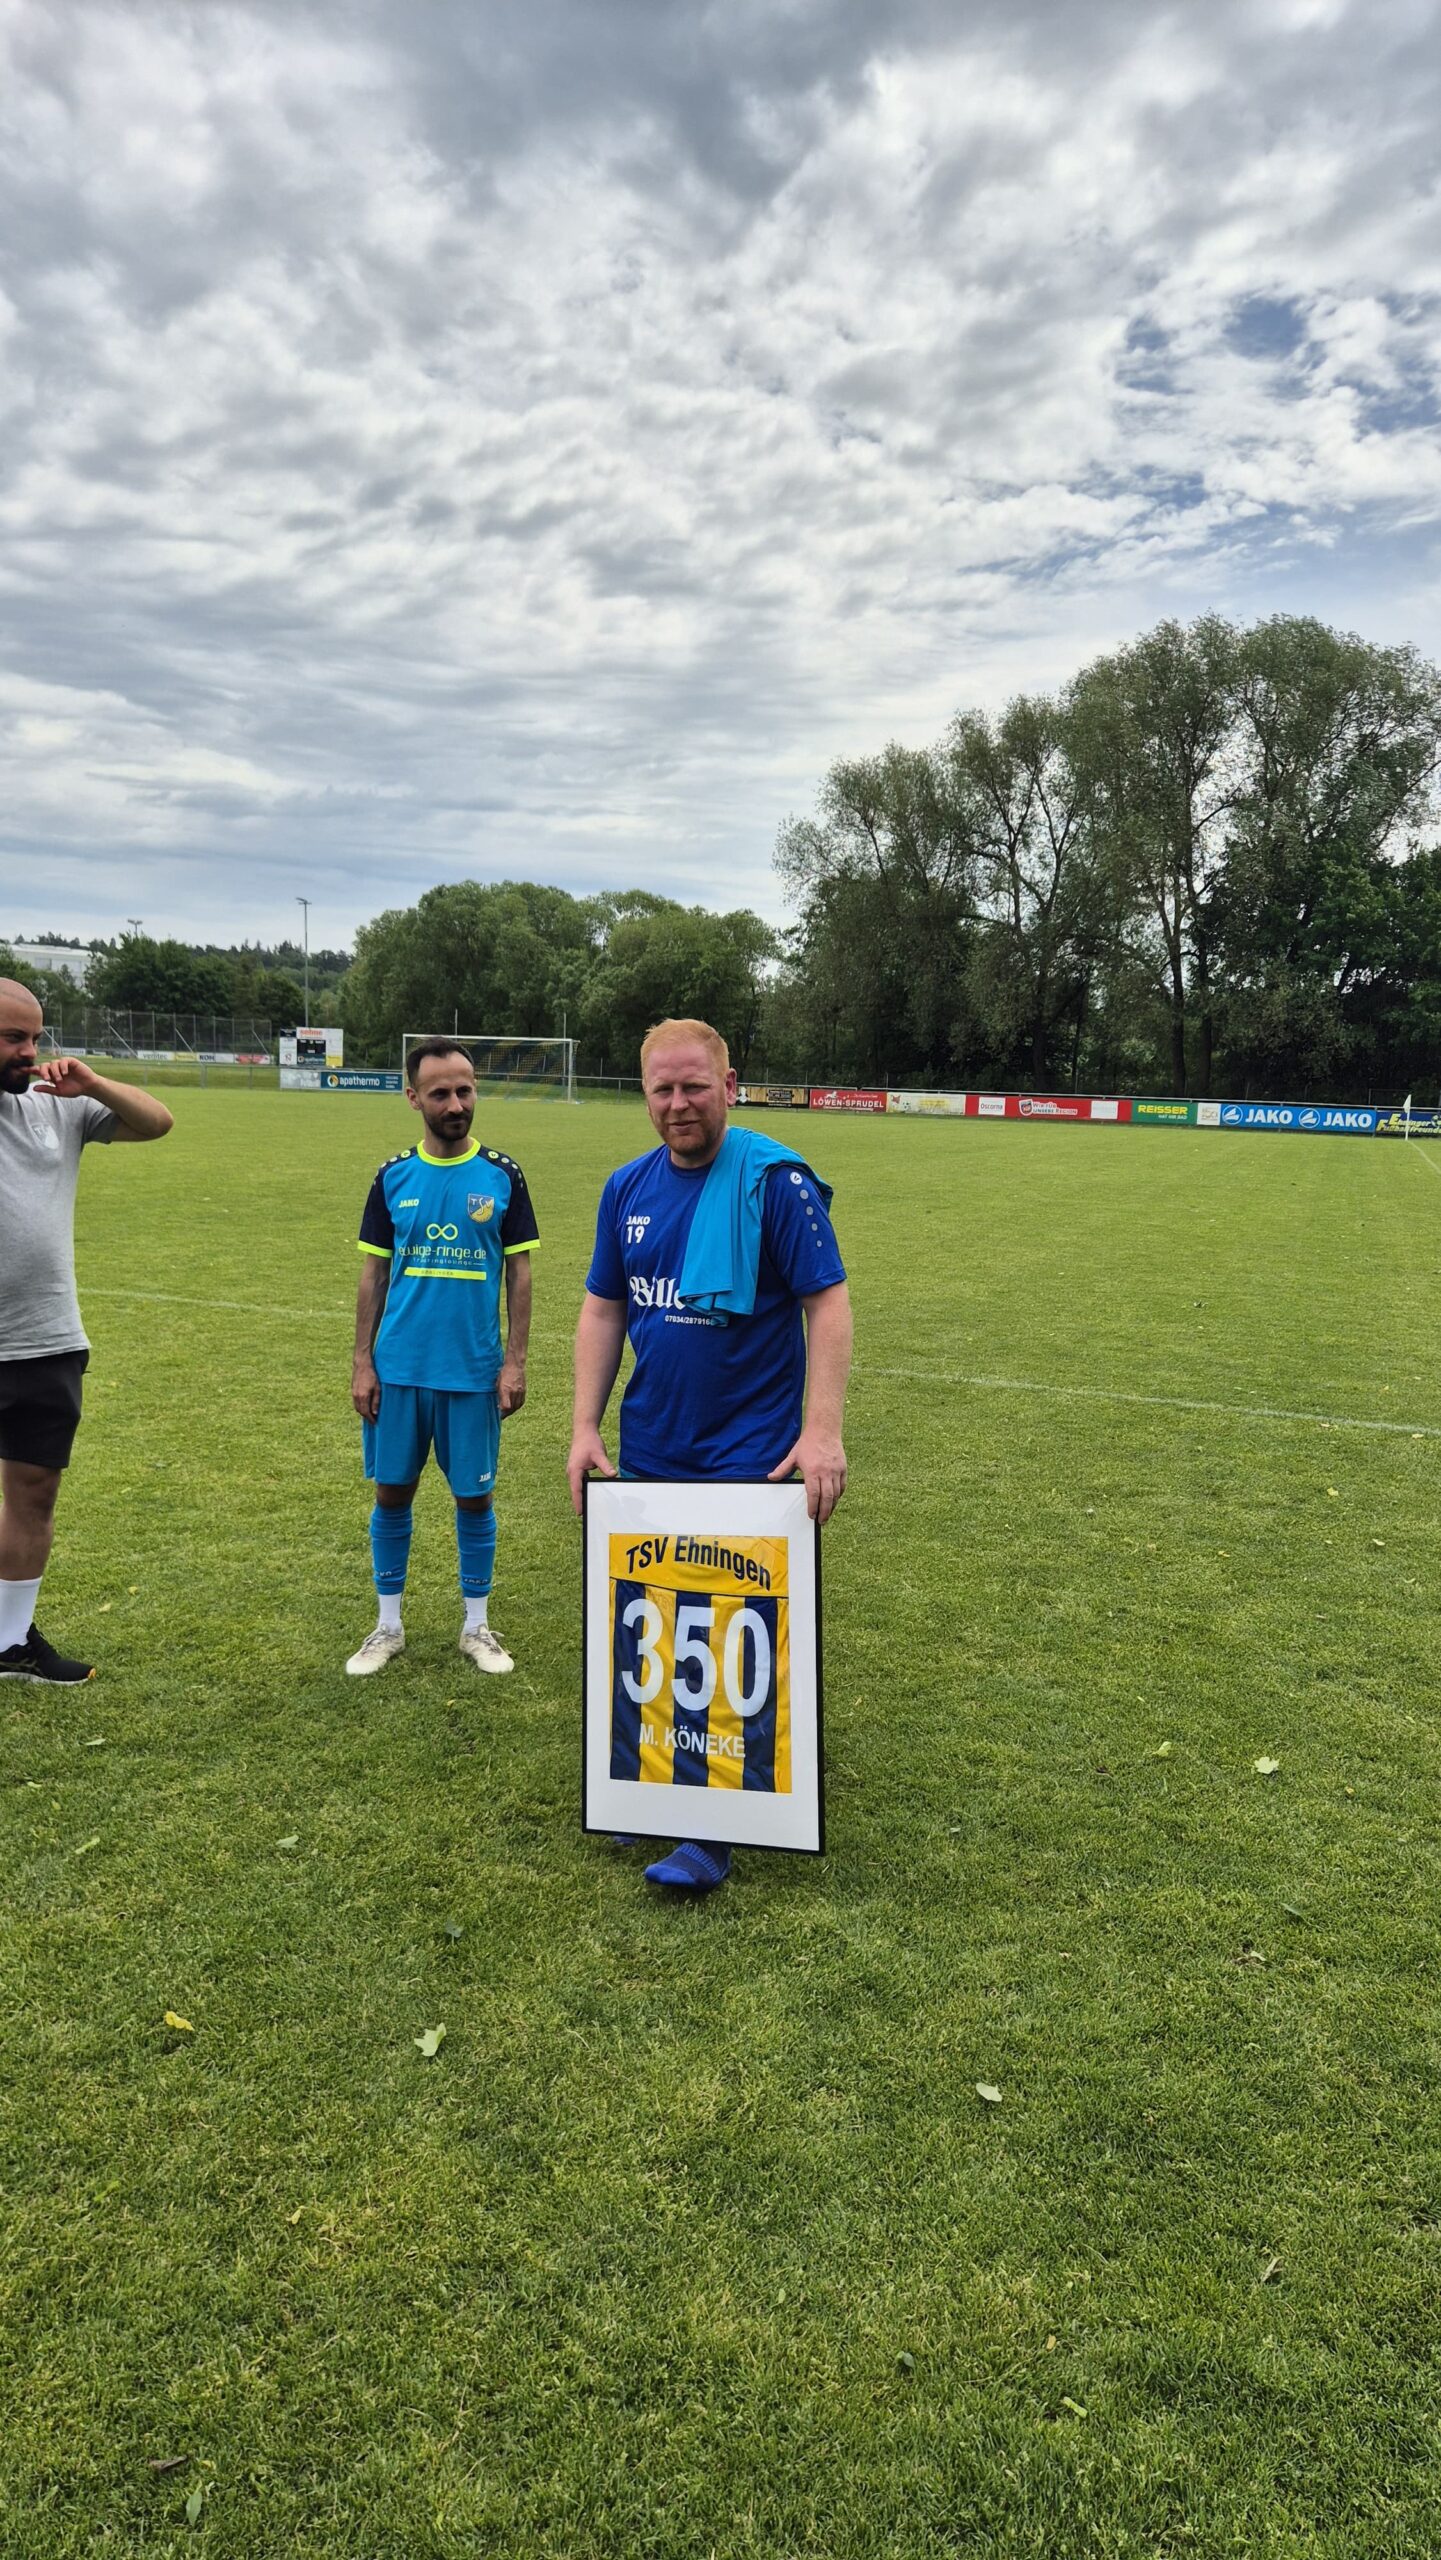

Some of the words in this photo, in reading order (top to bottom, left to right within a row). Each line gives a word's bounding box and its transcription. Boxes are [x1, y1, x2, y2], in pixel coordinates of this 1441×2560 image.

[339, 1075, 380, 1087] apathermo
[813, 1096, 884, 1109] LÖWEN-SPRUDEL
[1137, 1104, 1188, 1115] REISSER
[1245, 1108, 1293, 1125] JAKO
[1322, 1112, 1372, 1128] JAKO
[398, 1199, 420, 1208] JAKO
[626, 1216, 651, 1225] JAKO
[627, 1226, 645, 1244] 19
[625, 1536, 669, 1574] TSV
[674, 1536, 771, 1591] Ehningen
[621, 1598, 771, 1717] 350
[638, 1723, 658, 1747] M.
[664, 1726, 746, 1758] KÖNEKE
